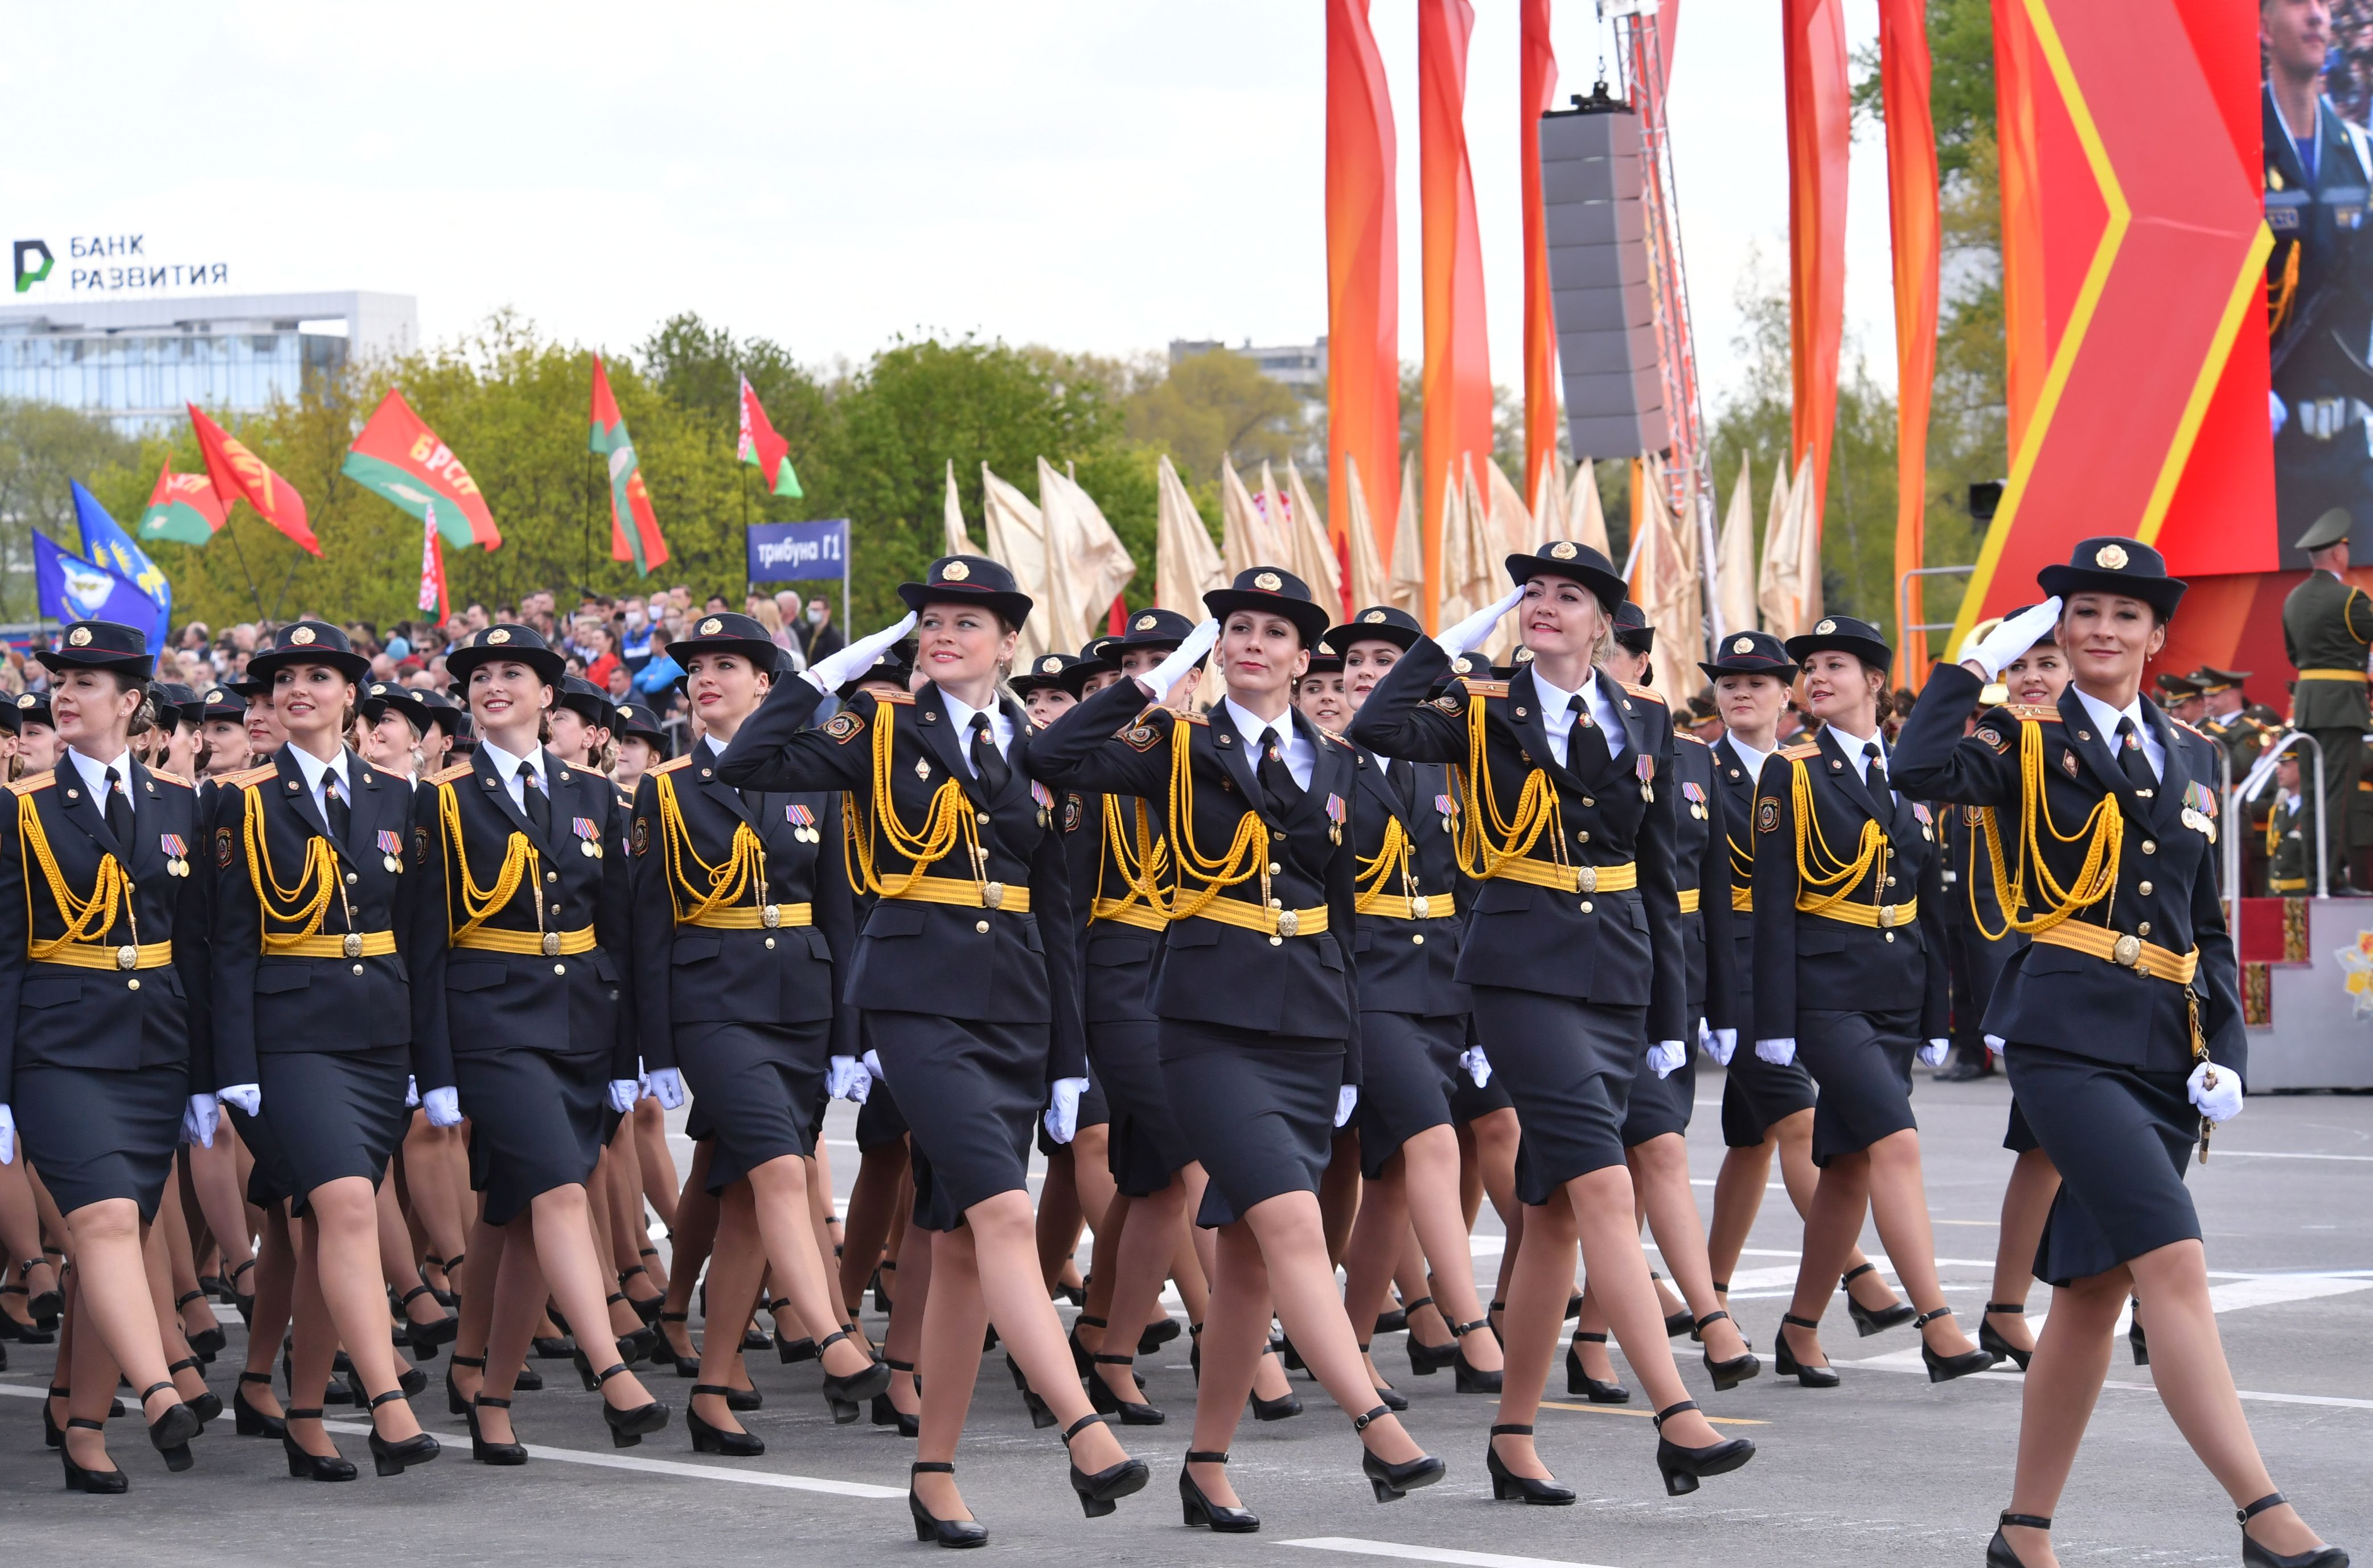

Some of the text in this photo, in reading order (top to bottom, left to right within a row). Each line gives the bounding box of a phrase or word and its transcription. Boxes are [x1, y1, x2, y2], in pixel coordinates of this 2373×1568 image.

[70, 234, 144, 258] БАНК
[71, 263, 228, 290] РАЗВИТИЯ
[757, 534, 841, 569] трибуна Г1
